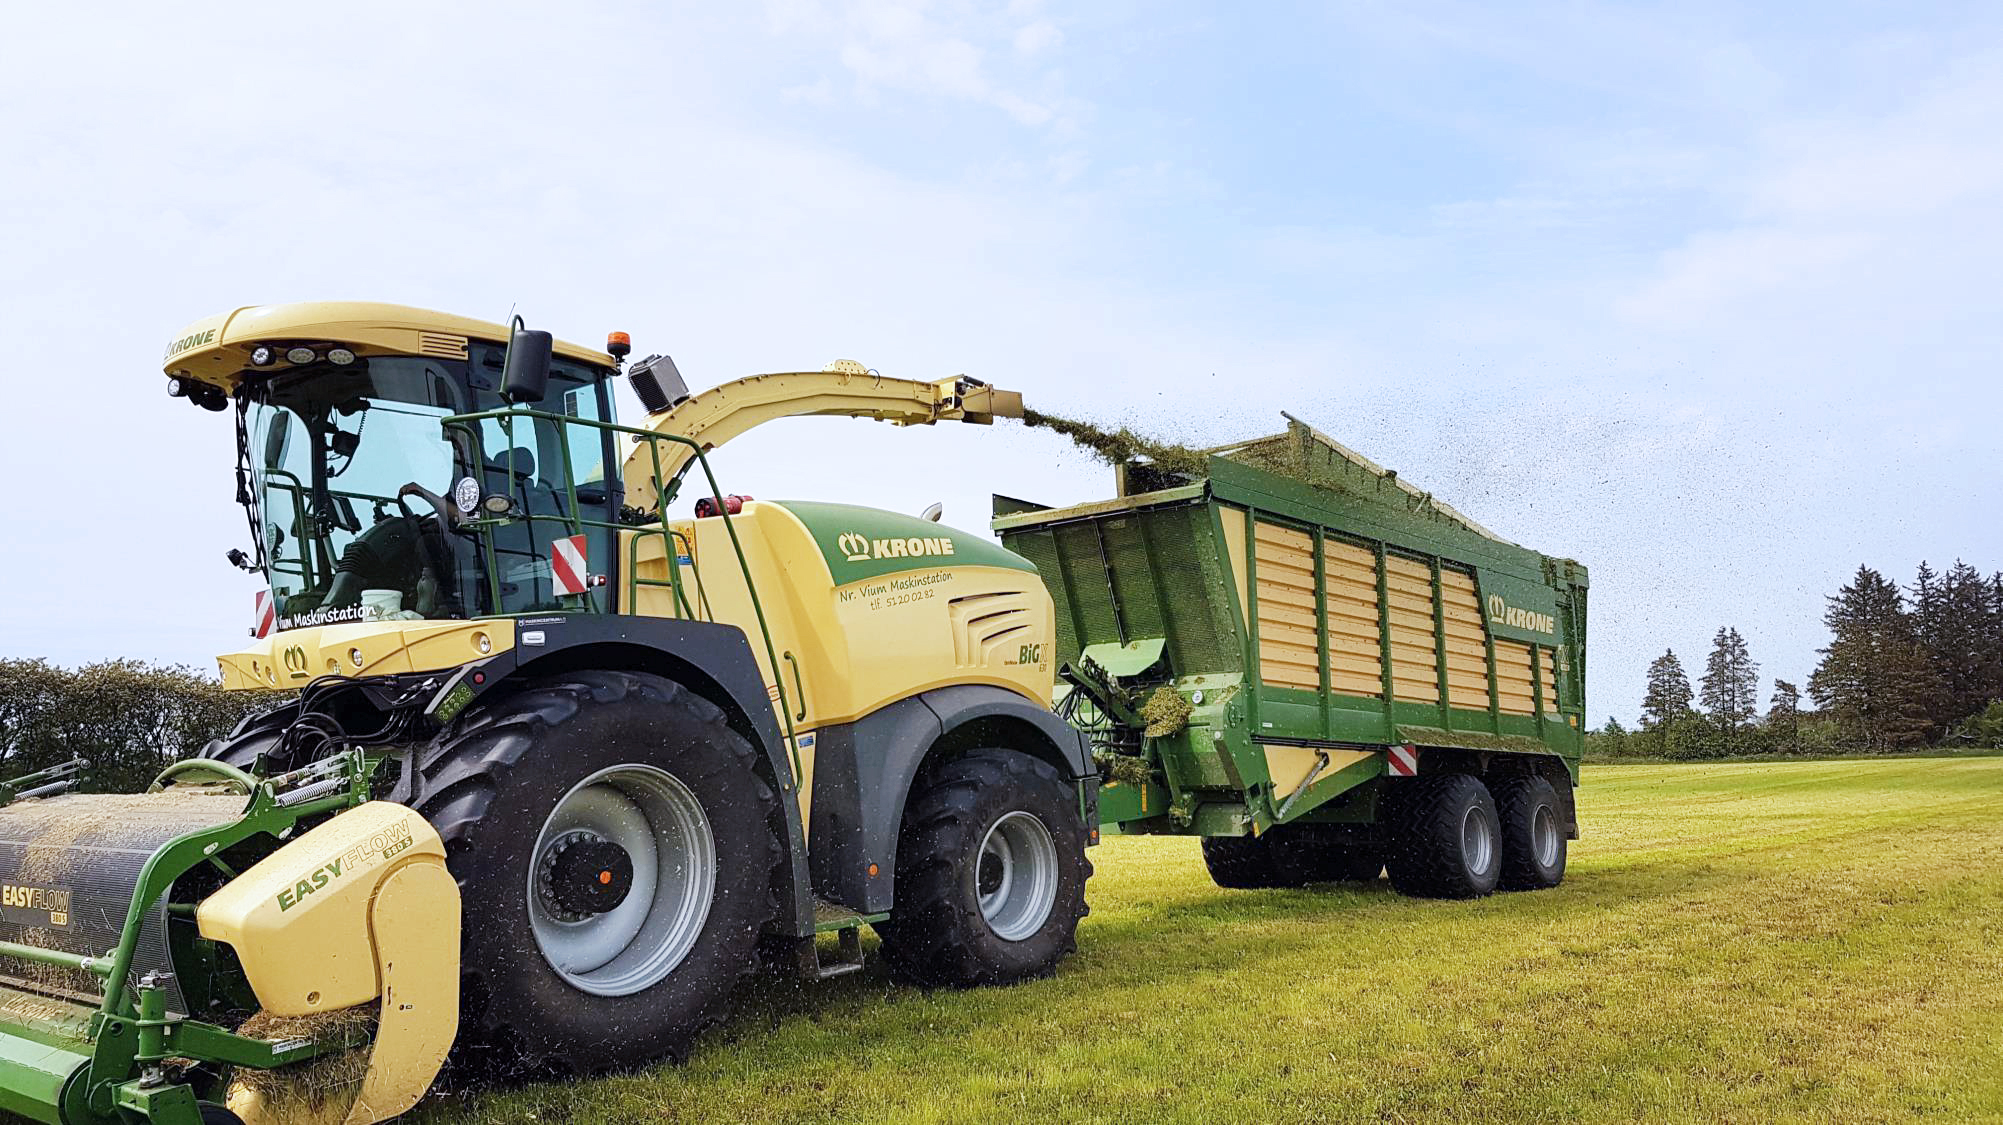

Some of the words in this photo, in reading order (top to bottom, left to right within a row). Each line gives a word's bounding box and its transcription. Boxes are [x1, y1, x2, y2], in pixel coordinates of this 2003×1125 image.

[168, 329, 216, 354] KRONE
[872, 537, 954, 559] KRONE
[839, 589, 857, 603] Nr.
[859, 584, 887, 598] Vium
[890, 570, 953, 592] Maskinstation
[293, 603, 377, 628] Maskinstation
[870, 598, 883, 611] tlf.
[1506, 606, 1555, 634] KRONE
[2, 884, 70, 913] EASYFLOW
